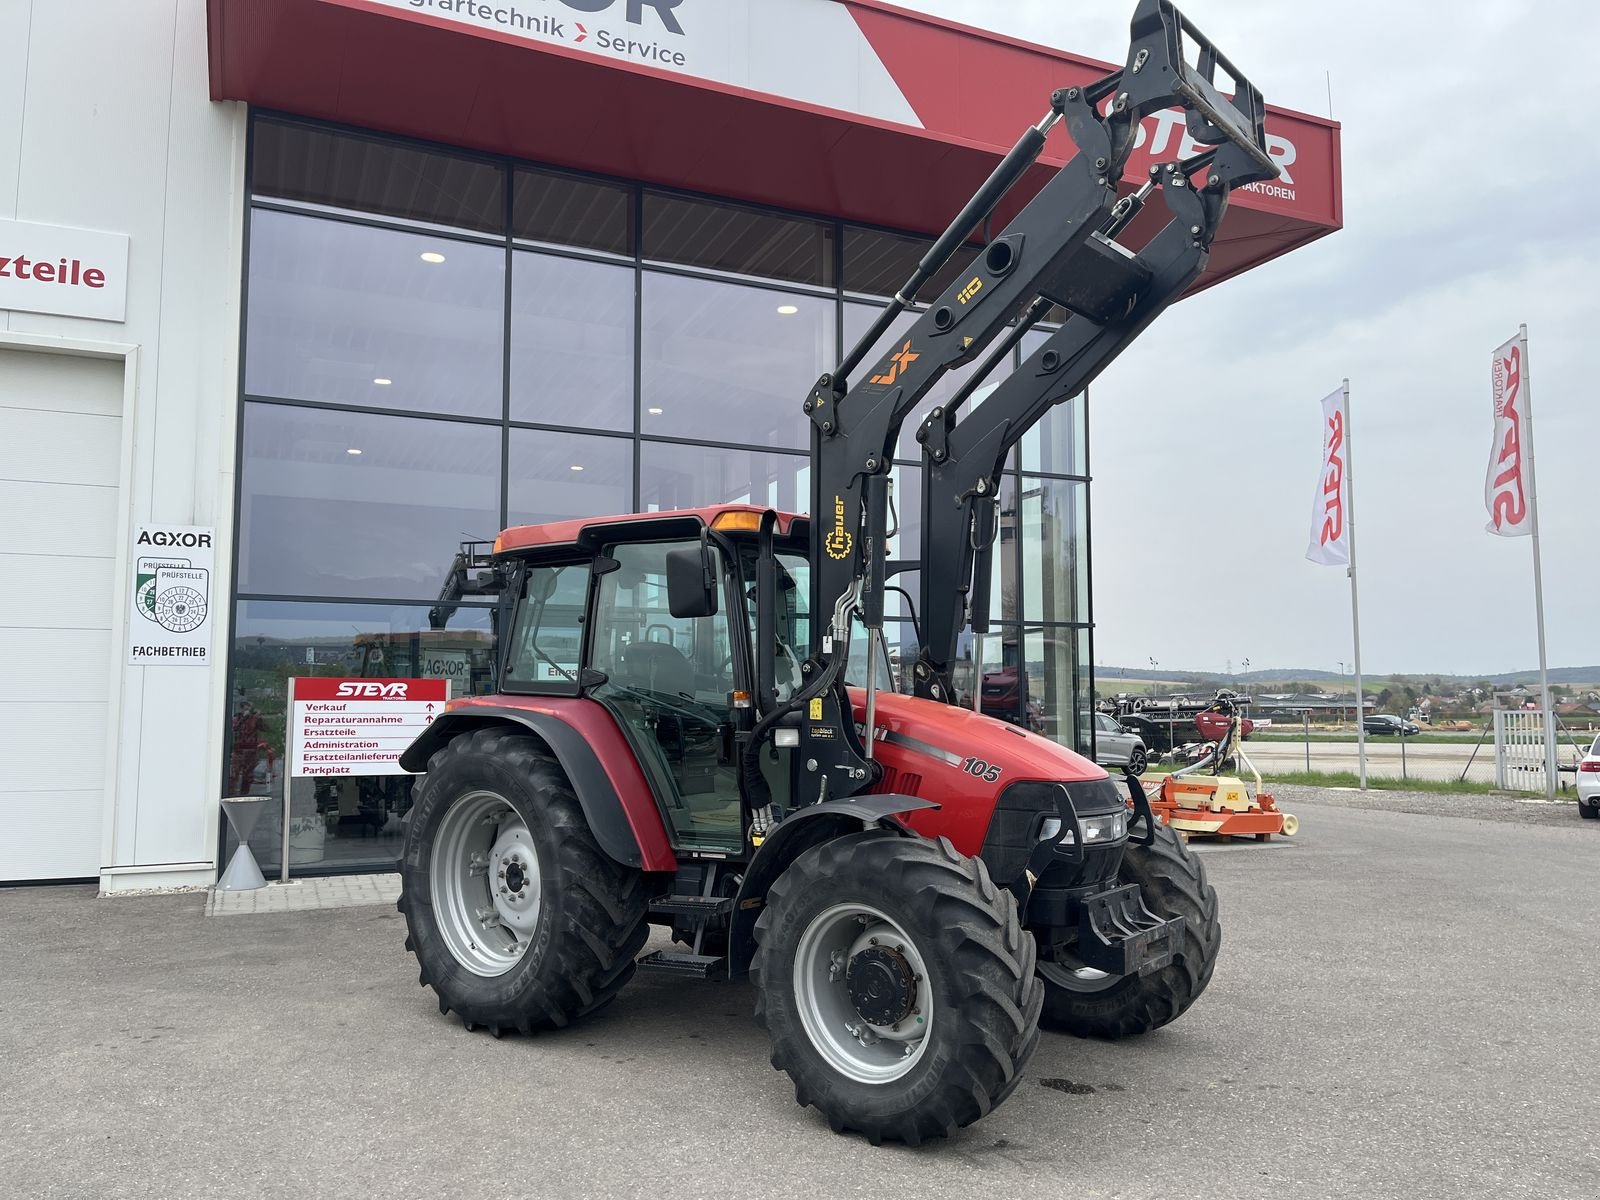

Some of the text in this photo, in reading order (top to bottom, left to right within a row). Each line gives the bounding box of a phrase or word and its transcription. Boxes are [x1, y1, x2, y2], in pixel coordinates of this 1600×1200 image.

[596, 30, 686, 66] Service
[957, 276, 983, 305] 110
[831, 495, 844, 549] hauer
[136, 530, 212, 549] AGXOR
[161, 571, 204, 580] PRÜFSTELLE
[132, 645, 207, 657] FACHBETRIEB
[424, 658, 464, 677] AGXOR
[336, 682, 409, 697] STEYR
[306, 703, 347, 711] Verkauf
[304, 715, 403, 726] Reparaturannahme
[304, 728, 356, 736] Ersatzteile
[304, 740, 379, 749] Administration
[302, 766, 351, 776] Parkplatz
[963, 756, 1003, 783] 105
